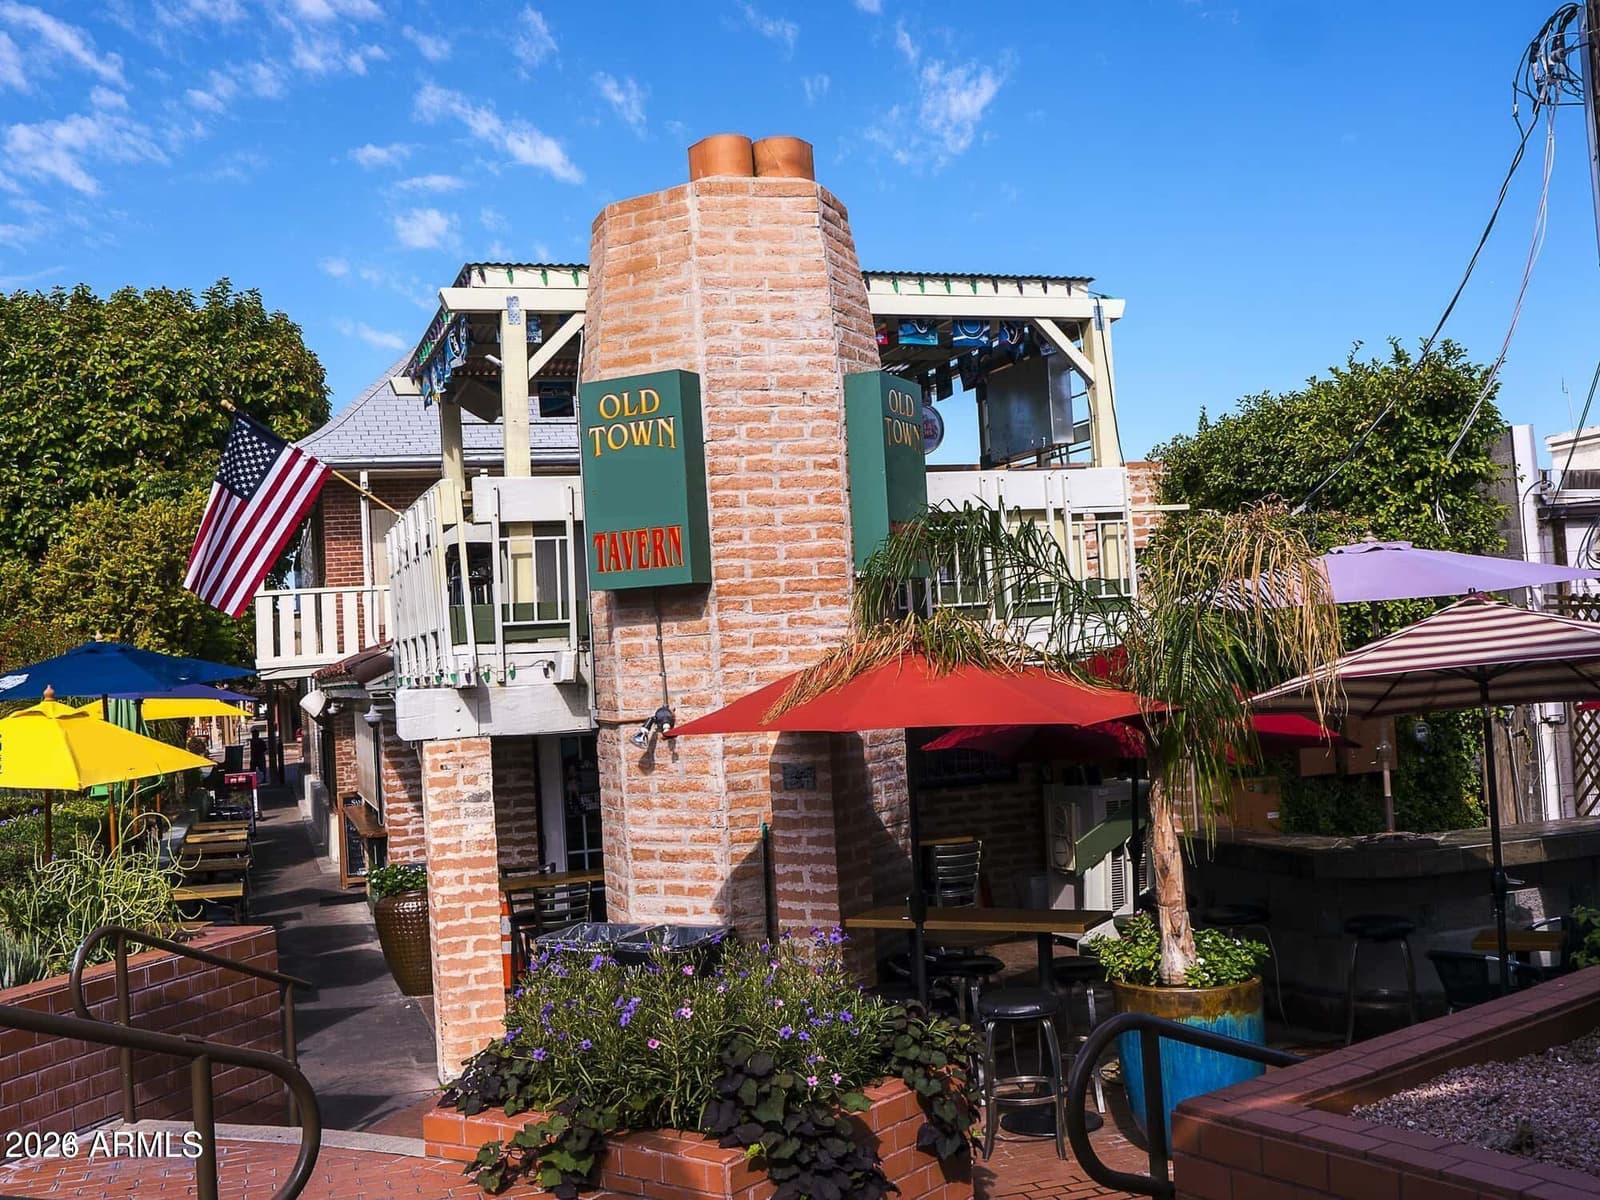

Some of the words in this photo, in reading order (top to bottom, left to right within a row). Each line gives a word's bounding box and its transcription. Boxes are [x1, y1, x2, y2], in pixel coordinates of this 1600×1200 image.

[599, 388, 660, 420] OLD
[888, 388, 915, 417] OLD
[588, 416, 676, 458] TOWN
[884, 416, 922, 455] TOWN
[592, 526, 685, 574] TAVERN
